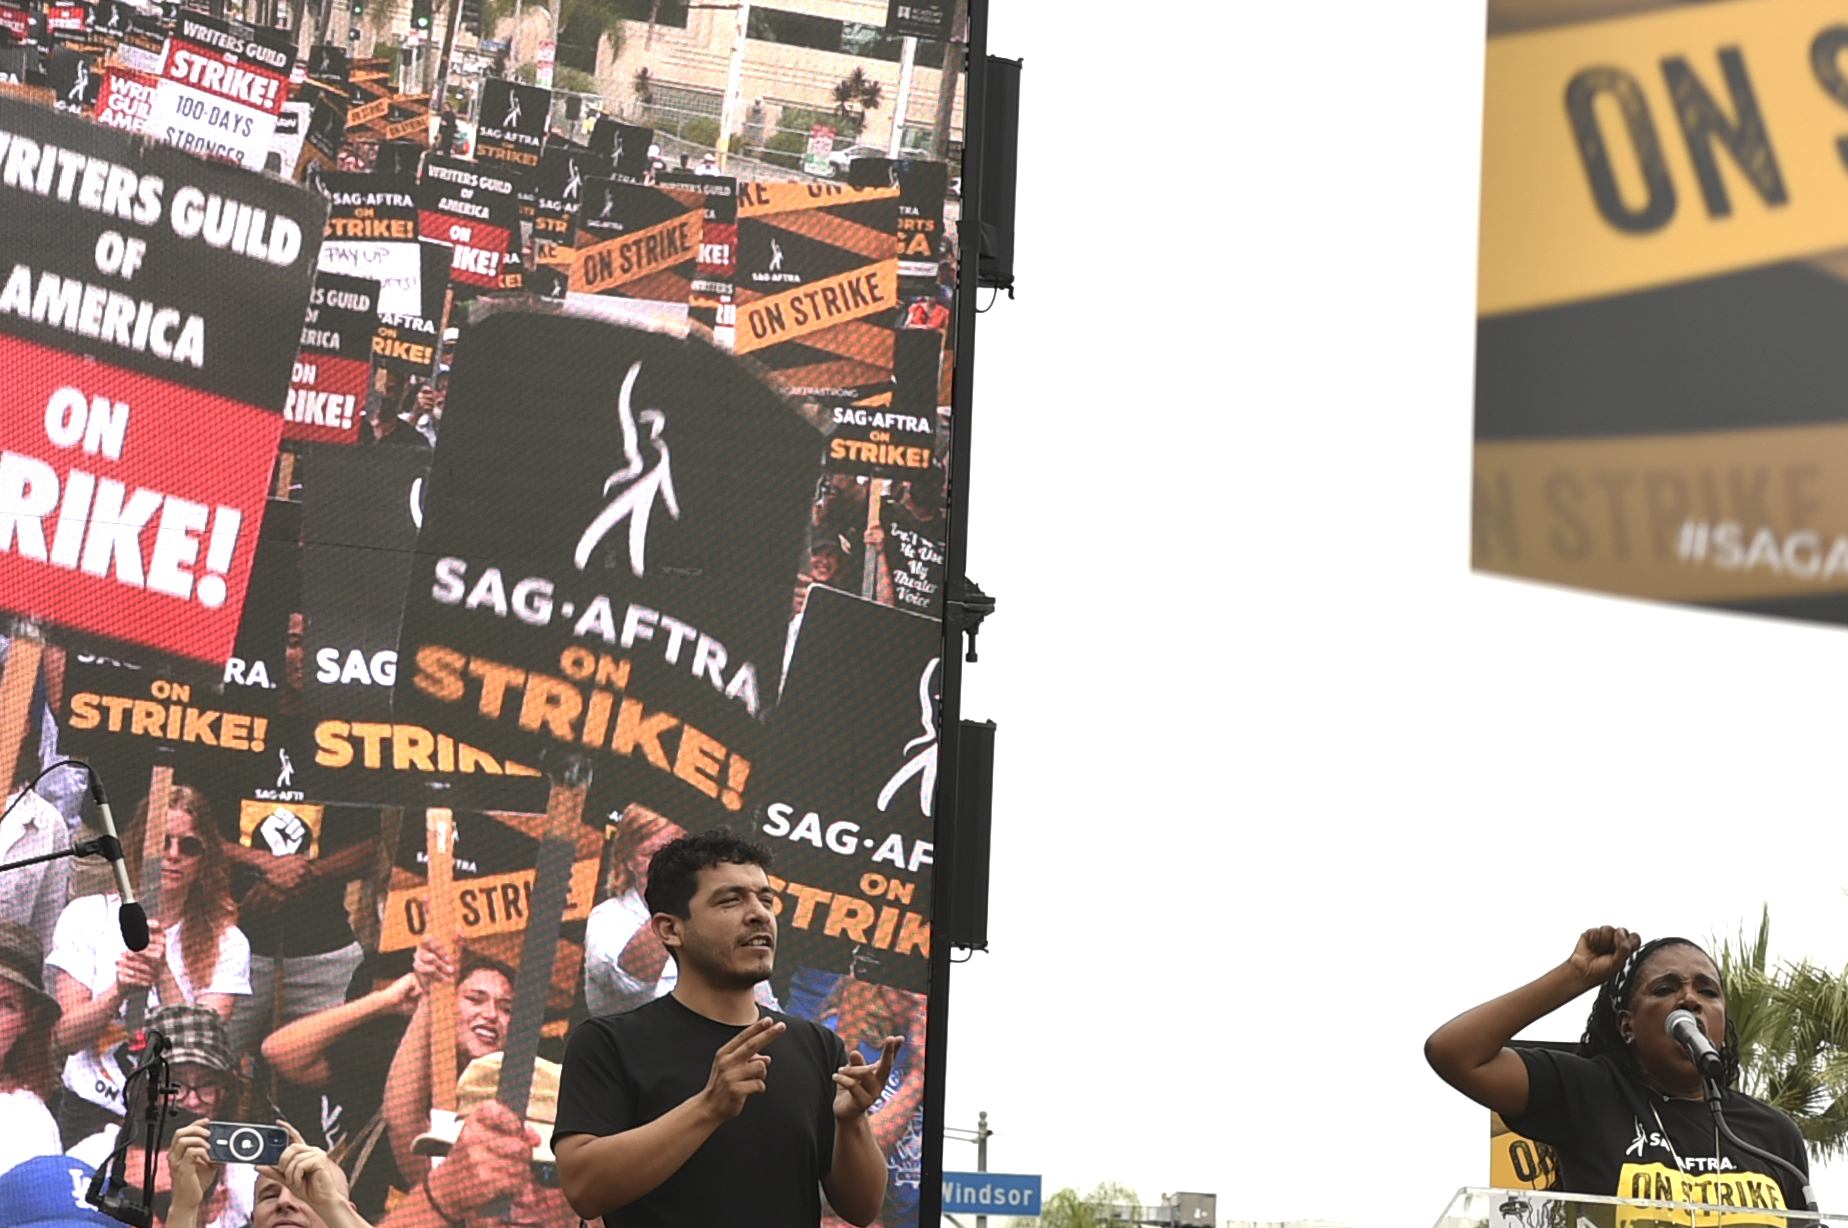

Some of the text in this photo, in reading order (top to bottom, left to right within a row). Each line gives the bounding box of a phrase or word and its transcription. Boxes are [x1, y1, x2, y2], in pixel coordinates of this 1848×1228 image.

[183, 19, 243, 54] WRITERS
[245, 43, 287, 68] GUILD
[171, 48, 280, 109] STRIKE!
[208, 105, 253, 138] DAYS
[1563, 44, 1791, 239] ON
[428, 164, 513, 194] WRITERS GUILD
[460, 188, 475, 199] OF
[170, 185, 302, 267] GUILD
[438, 197, 490, 219] AMERICA
[449, 225, 472, 242] ON
[583, 221, 690, 286] ON STRIKE
[95, 230, 147, 281] OF
[324, 246, 390, 267] PAY UP
[0, 264, 205, 369] AMERICA
[326, 288, 371, 312] GUILD
[749, 303, 786, 339] ON
[789, 272, 885, 327] STRIKE
[292, 363, 317, 384] ON
[44, 386, 130, 461] ON
[869, 430, 890, 443] ON
[830, 438, 932, 469] STRIKE!
[560, 645, 632, 691] ON
[151, 680, 191, 703] ON
[68, 692, 269, 753] STRIKE!
[413, 644, 751, 811] STRIKE!
[859, 872, 916, 907] ON
[95, 1079, 120, 1102] ON
[1632, 1172, 1787, 1221] ON STRIKE
